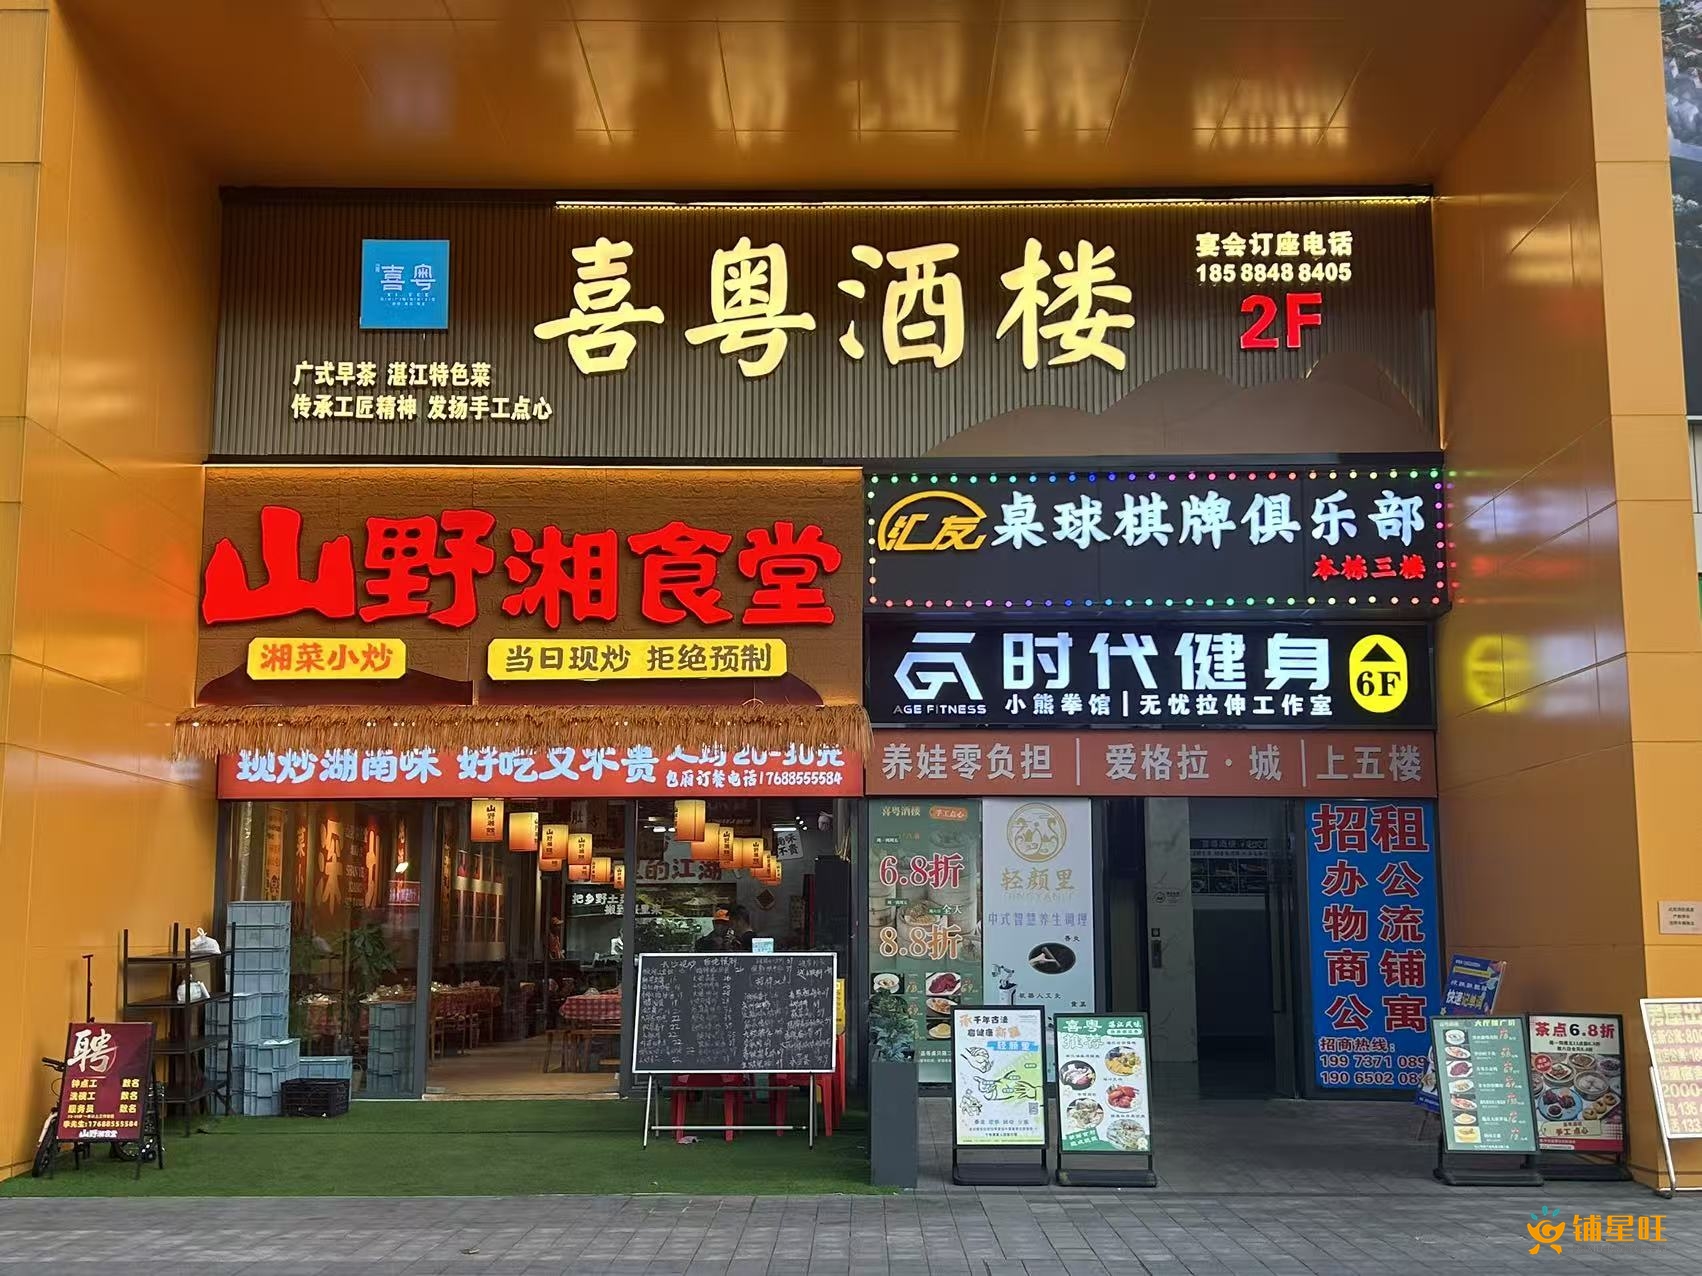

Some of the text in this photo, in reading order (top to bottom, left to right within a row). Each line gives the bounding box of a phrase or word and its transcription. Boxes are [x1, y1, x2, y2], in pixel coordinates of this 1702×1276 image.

[1196, 231, 1353, 258] 宴会订座电话
[381, 264, 436, 291] 喜粤
[1197, 262, 1352, 282] 185 8848 8405
[534, 236, 1135, 378] 喜粤酒楼
[1240, 292, 1323, 350] 2F
[293, 361, 491, 388] 广式早茶 湛江特色菜
[291, 394, 553, 421] 传承工匠精神 发扬手工点心
[884, 511, 986, 552] 汇友
[992, 489, 1426, 550] 桌球棋牌俱乐部
[202, 505, 842, 628] 山野湘食堂
[260, 643, 394, 673] 湘菜小炒
[506, 644, 772, 673] 当日现炒 拒绝预制
[1003, 631, 1330, 691] 时代健身
[1356, 671, 1401, 697] 6F
[893, 704, 986, 715] AGE FITNESS
[1005, 693, 1333, 716] 小熊拳馆 无忧拉伸工作室
[236, 746, 442, 784] 现炒湖南味
[457, 745, 660, 783] 好吃又不贵
[881, 743, 1053, 780] 养娃零负担
[1316, 744, 1423, 782] 上五楼
[1312, 804, 1429, 853] 招租
[636, 858, 722, 880] 的江湖
[879, 852, 965, 890] 6.8折
[1001, 867, 1075, 891] 轻颜里
[1321, 859, 1423, 898] 办公
[988, 912, 1087, 926] 中式智慧养生调理
[1323, 904, 1425, 942] 物流
[879, 921, 963, 960] 8.8折
[1324, 948, 1426, 987] 商铺
[1063, 1019, 1102, 1032] 喜粤
[1326, 993, 1427, 1033] 公寓
[1535, 1021, 1615, 1038] 茶点6.8折
[67, 1028, 116, 1073] 聘
[1319, 1055, 1349, 1068] 199
[1353, 1055, 1392, 1068] 7371
[1319, 1071, 1422, 1085] 190 6502 08
